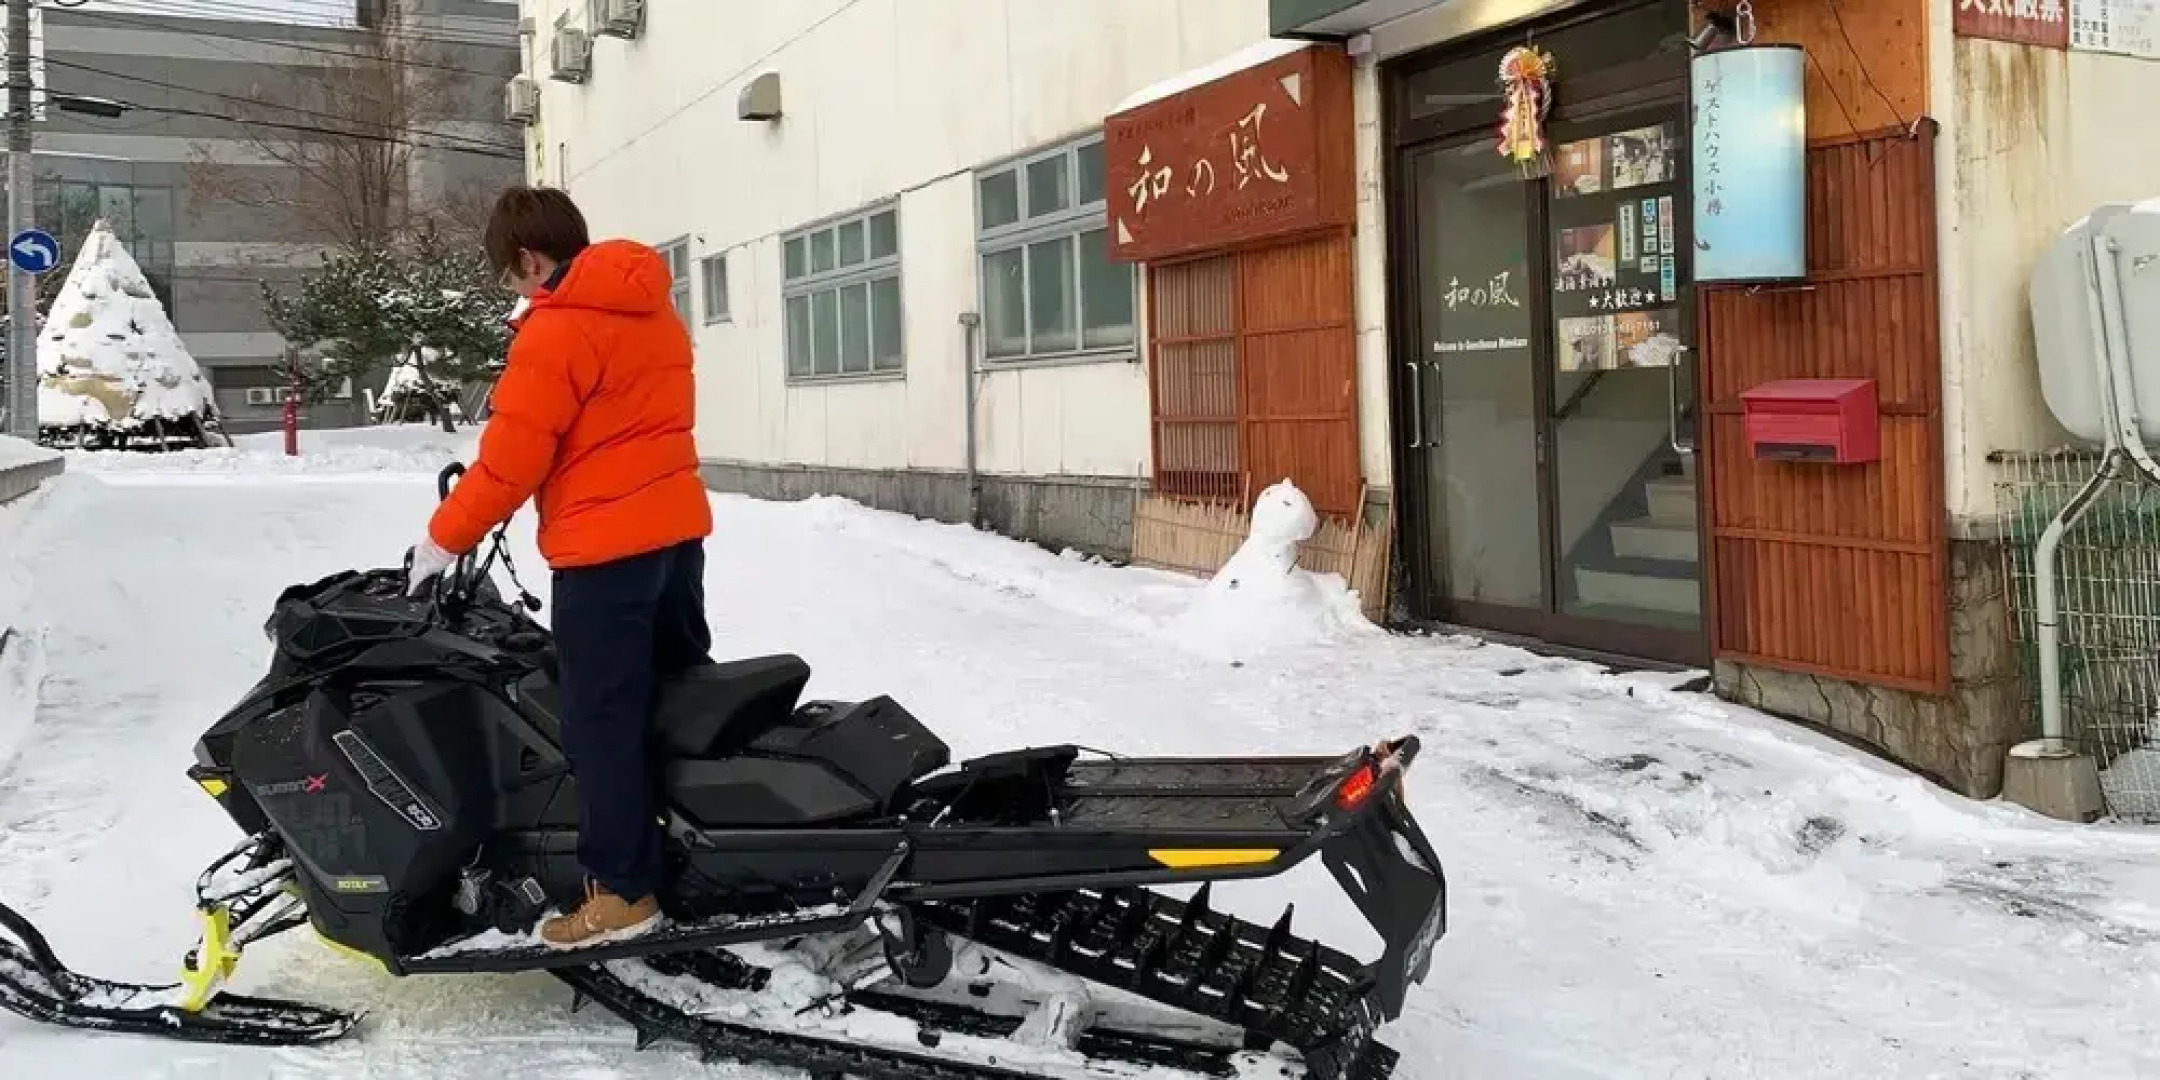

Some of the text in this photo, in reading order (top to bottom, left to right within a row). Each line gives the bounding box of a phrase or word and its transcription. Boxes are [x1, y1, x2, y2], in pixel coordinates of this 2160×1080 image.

[1127, 103, 1288, 214] 和の風
[1443, 271, 1520, 311] 和の風
